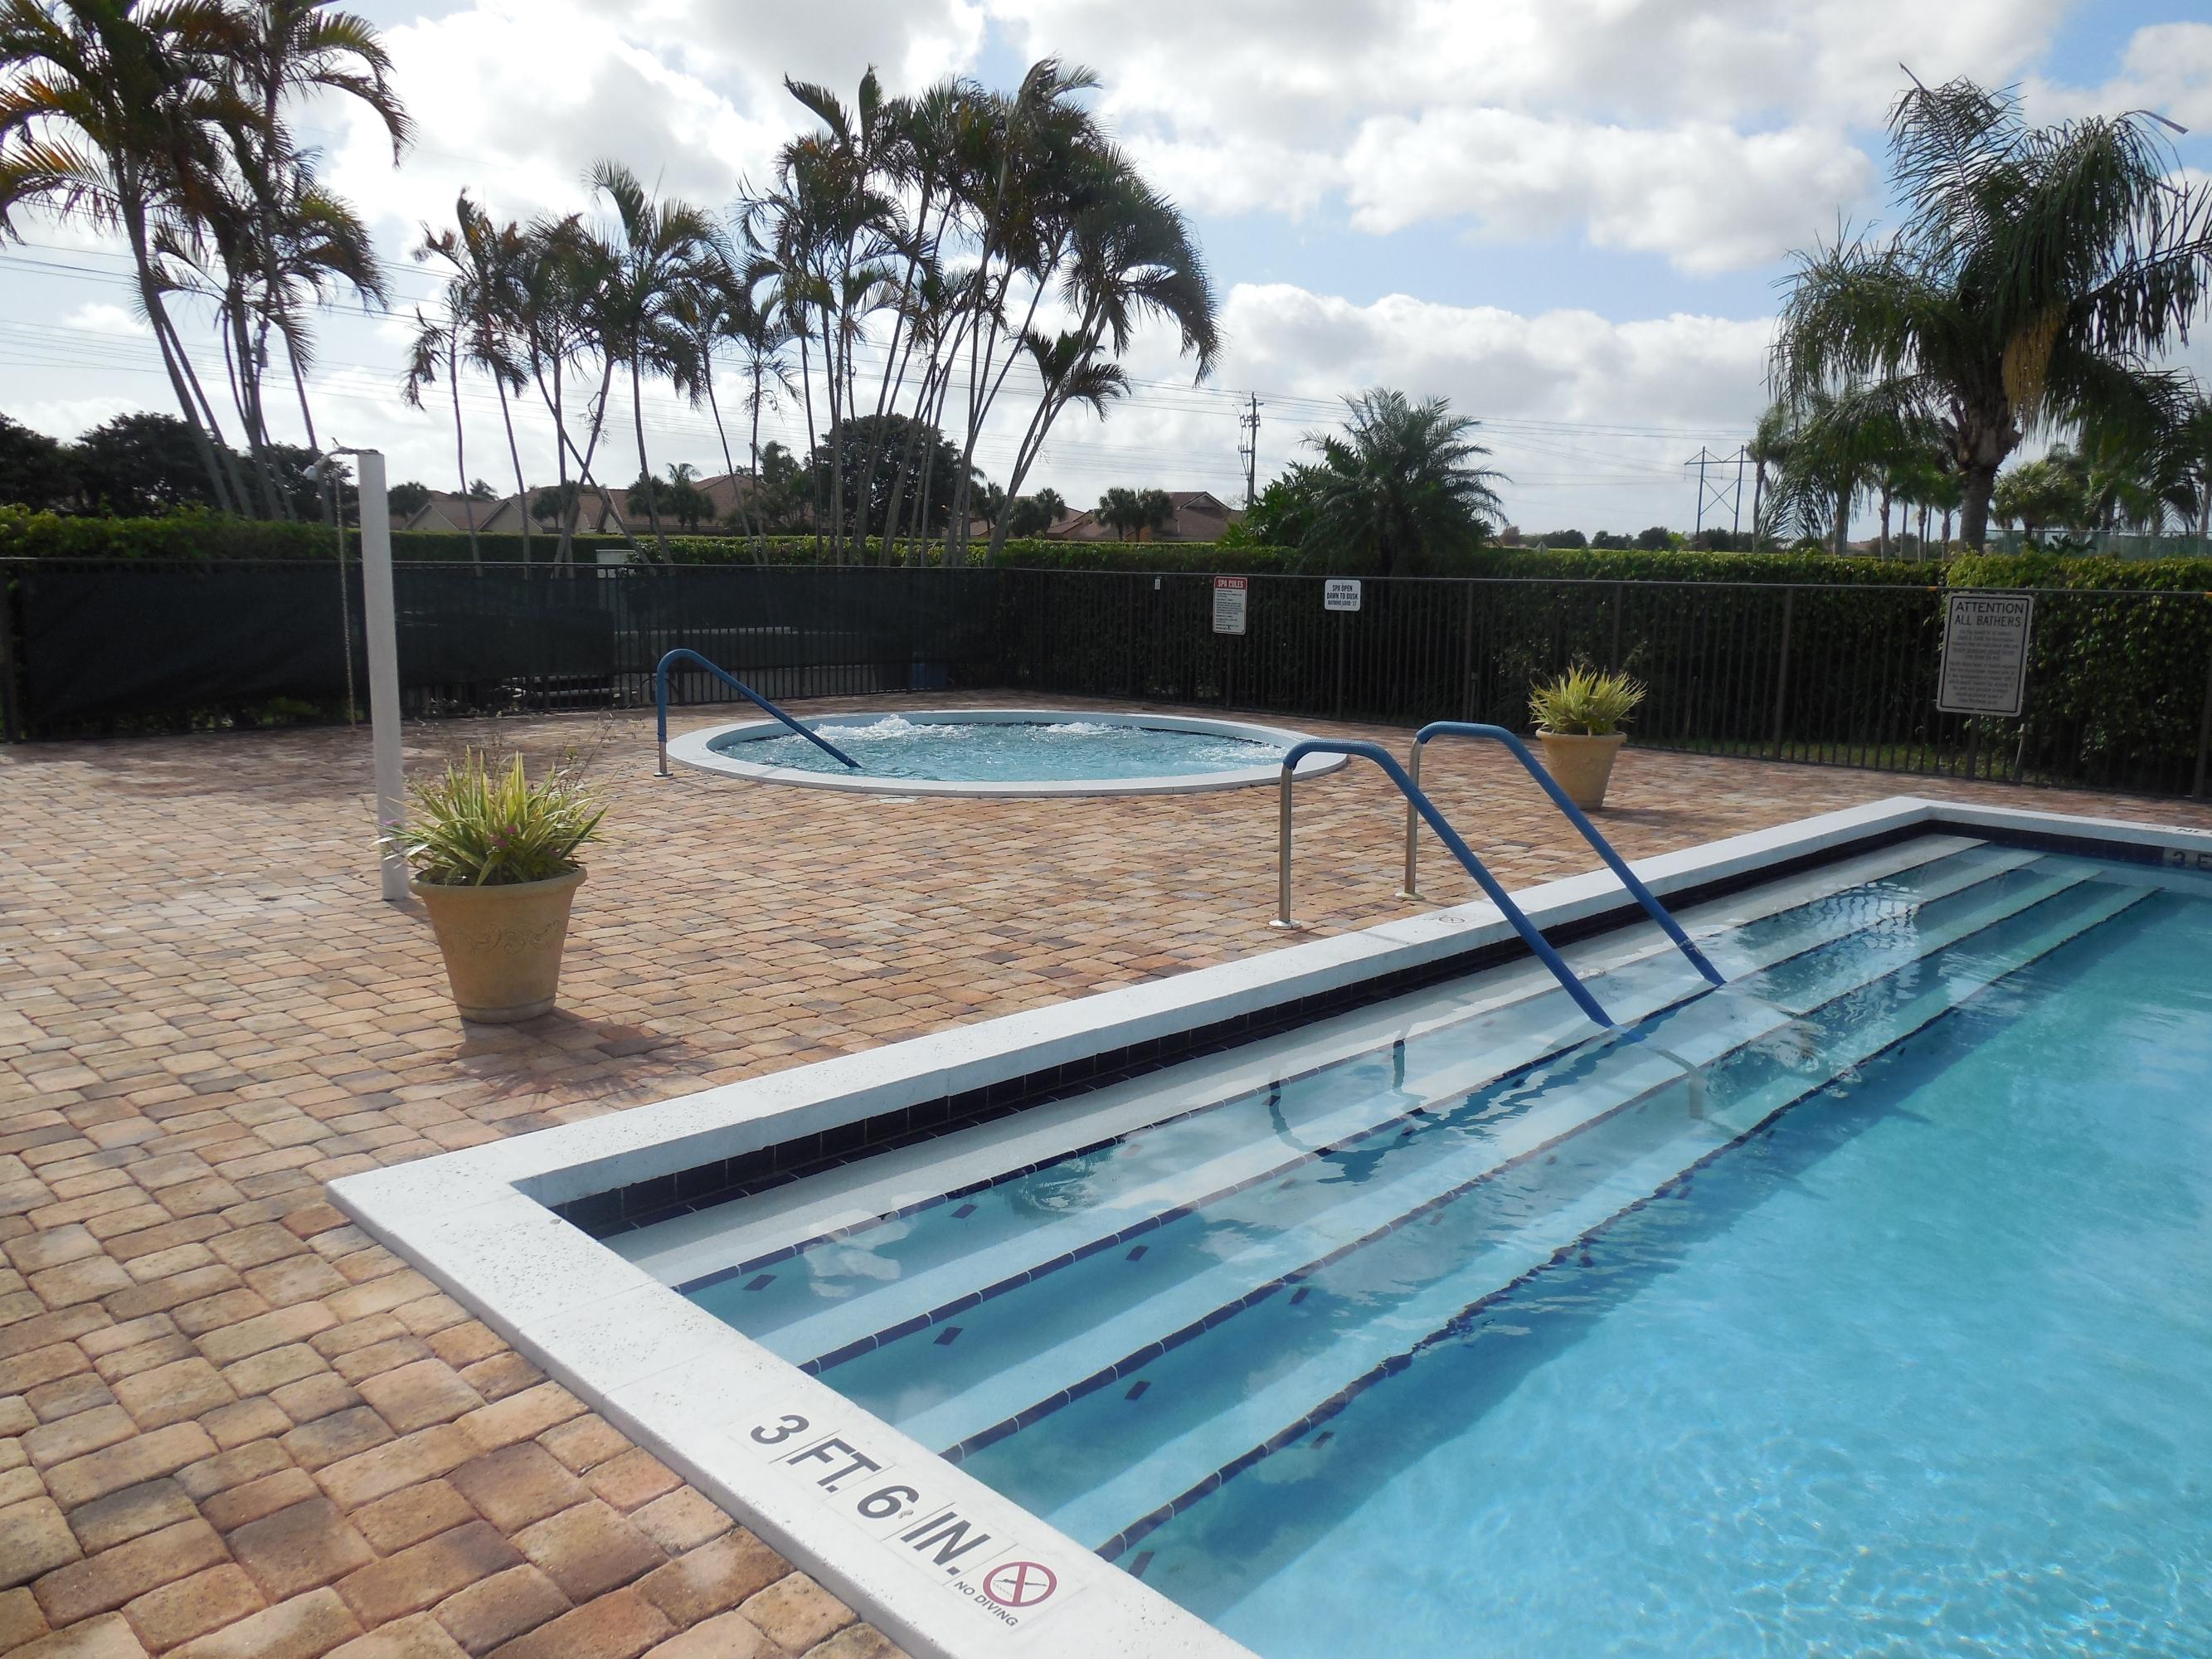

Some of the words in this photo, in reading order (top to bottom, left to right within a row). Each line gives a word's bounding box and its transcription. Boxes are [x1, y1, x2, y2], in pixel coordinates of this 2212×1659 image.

[1954, 615, 1971, 625] ALL
[1976, 615, 2021, 627] BATHERS
[1955, 601, 2024, 614] ATTENTION
[750, 1414, 810, 1445] 3
[785, 1438, 882, 1493] FT.
[857, 1485, 920, 1519] 6
[901, 1511, 992, 1576] IN.
[954, 1580, 975, 1594] NO
[974, 1594, 1018, 1628] DIVING
